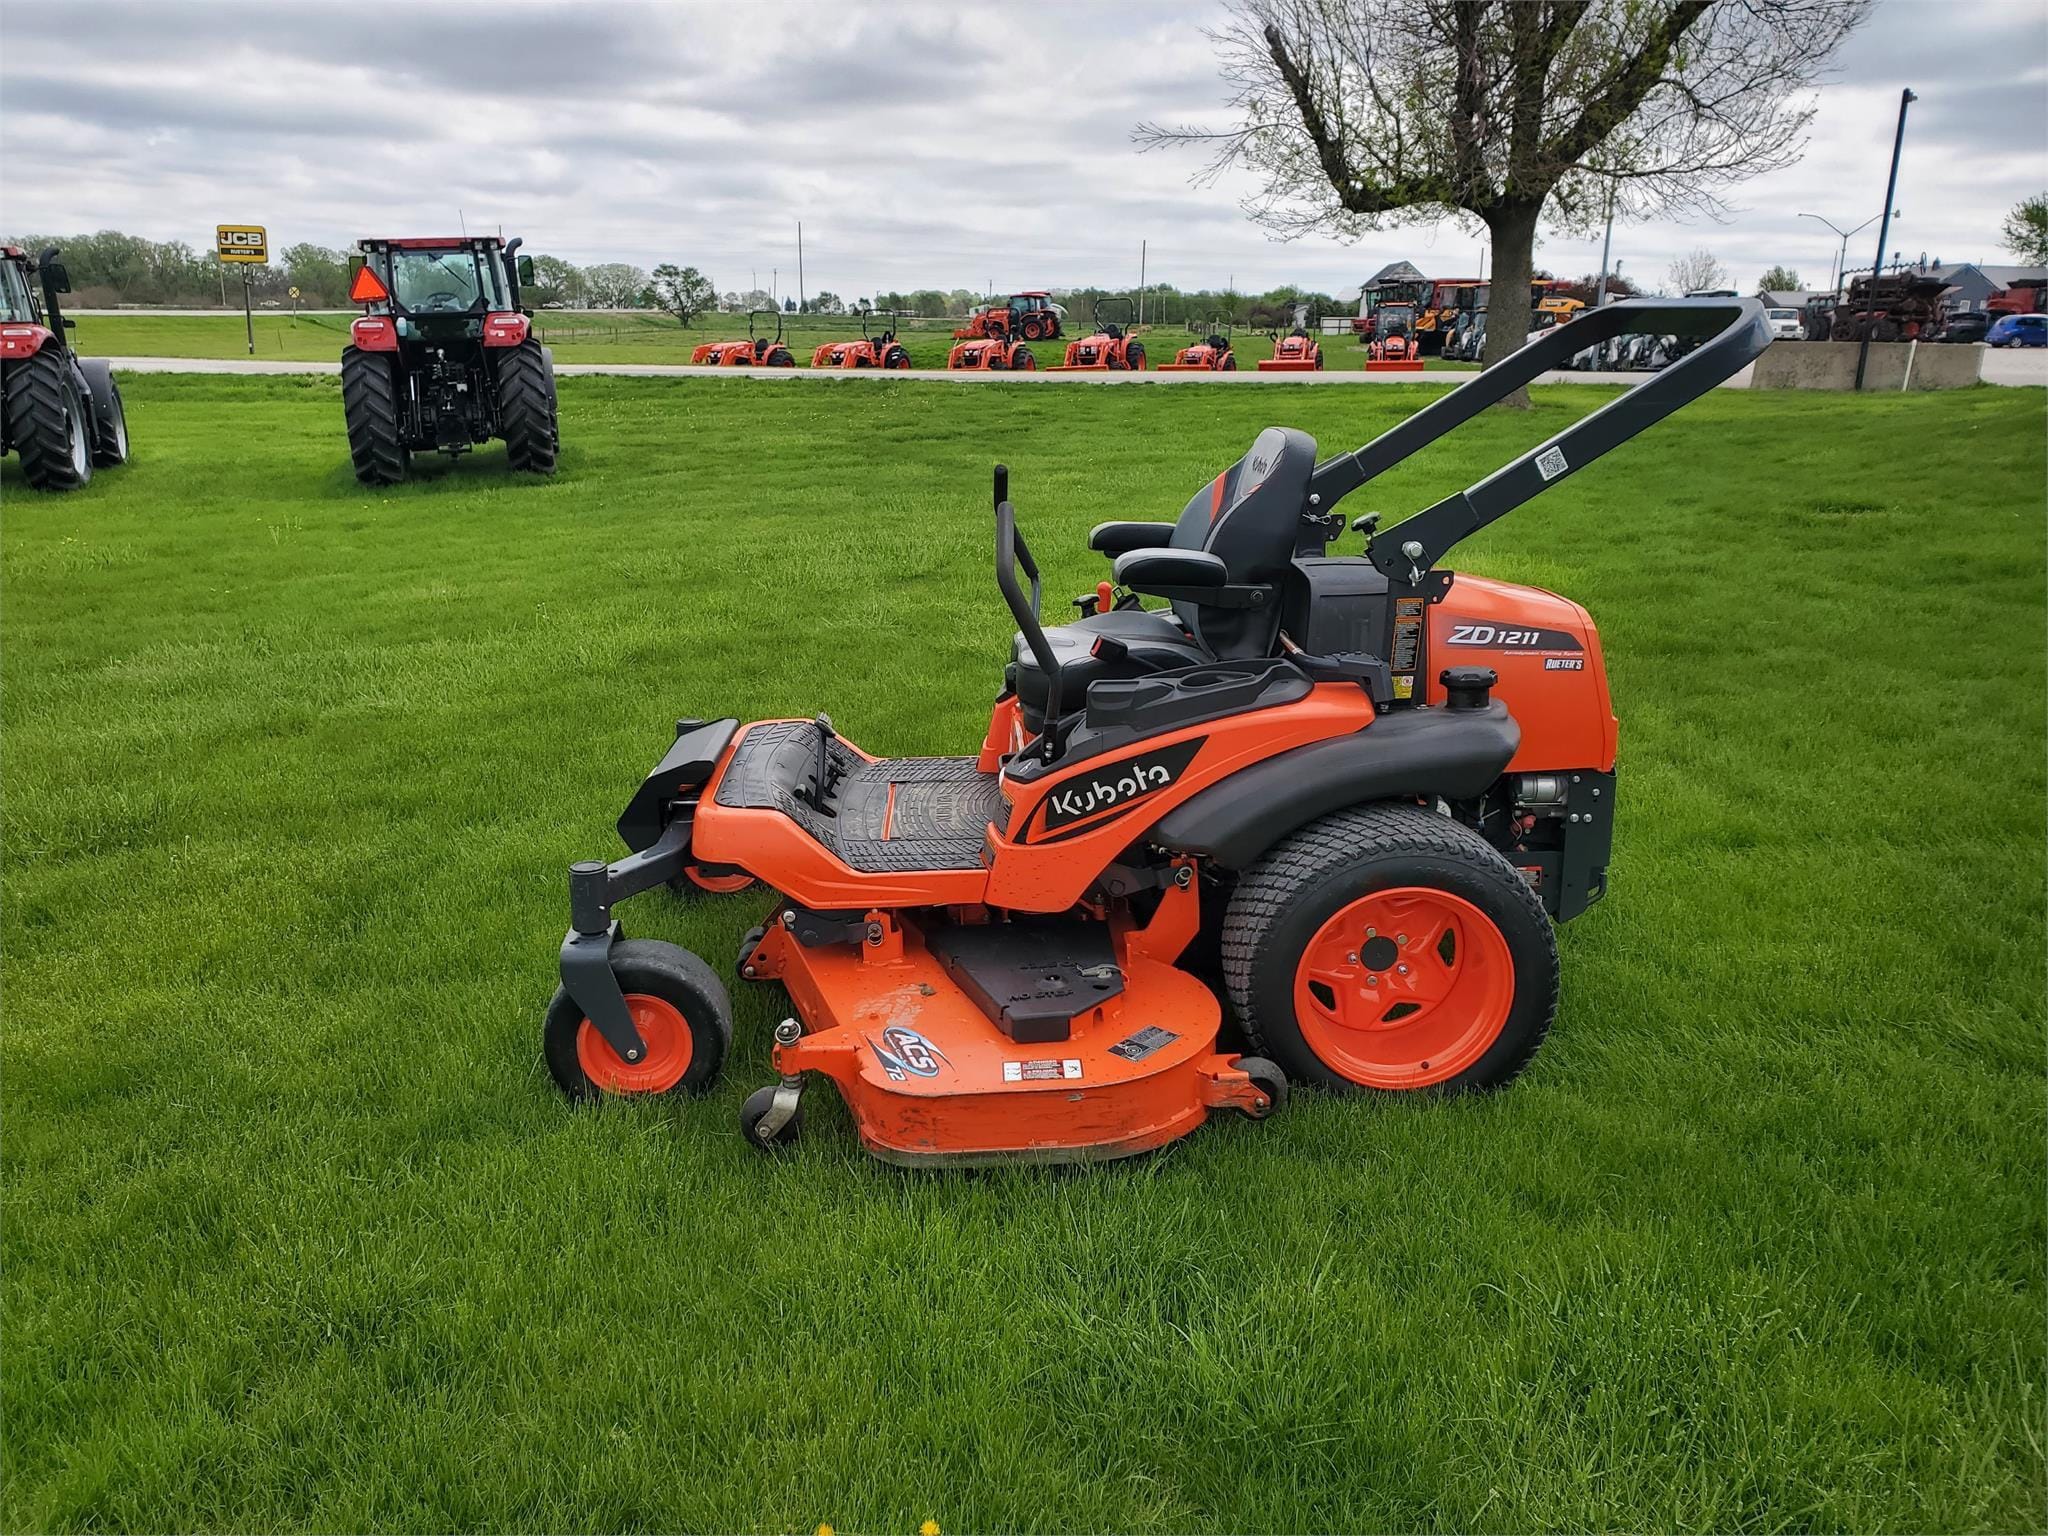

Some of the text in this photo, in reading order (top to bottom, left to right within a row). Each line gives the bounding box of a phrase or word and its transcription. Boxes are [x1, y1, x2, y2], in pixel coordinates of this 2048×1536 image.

[220, 232, 263, 246] JCB
[1447, 625, 1540, 645] ZD 1211
[1545, 658, 1583, 670] RUETER'S
[1052, 763, 1171, 815] Kubota
[893, 1033, 938, 1068] ACS
[886, 1066, 906, 1081] 72
